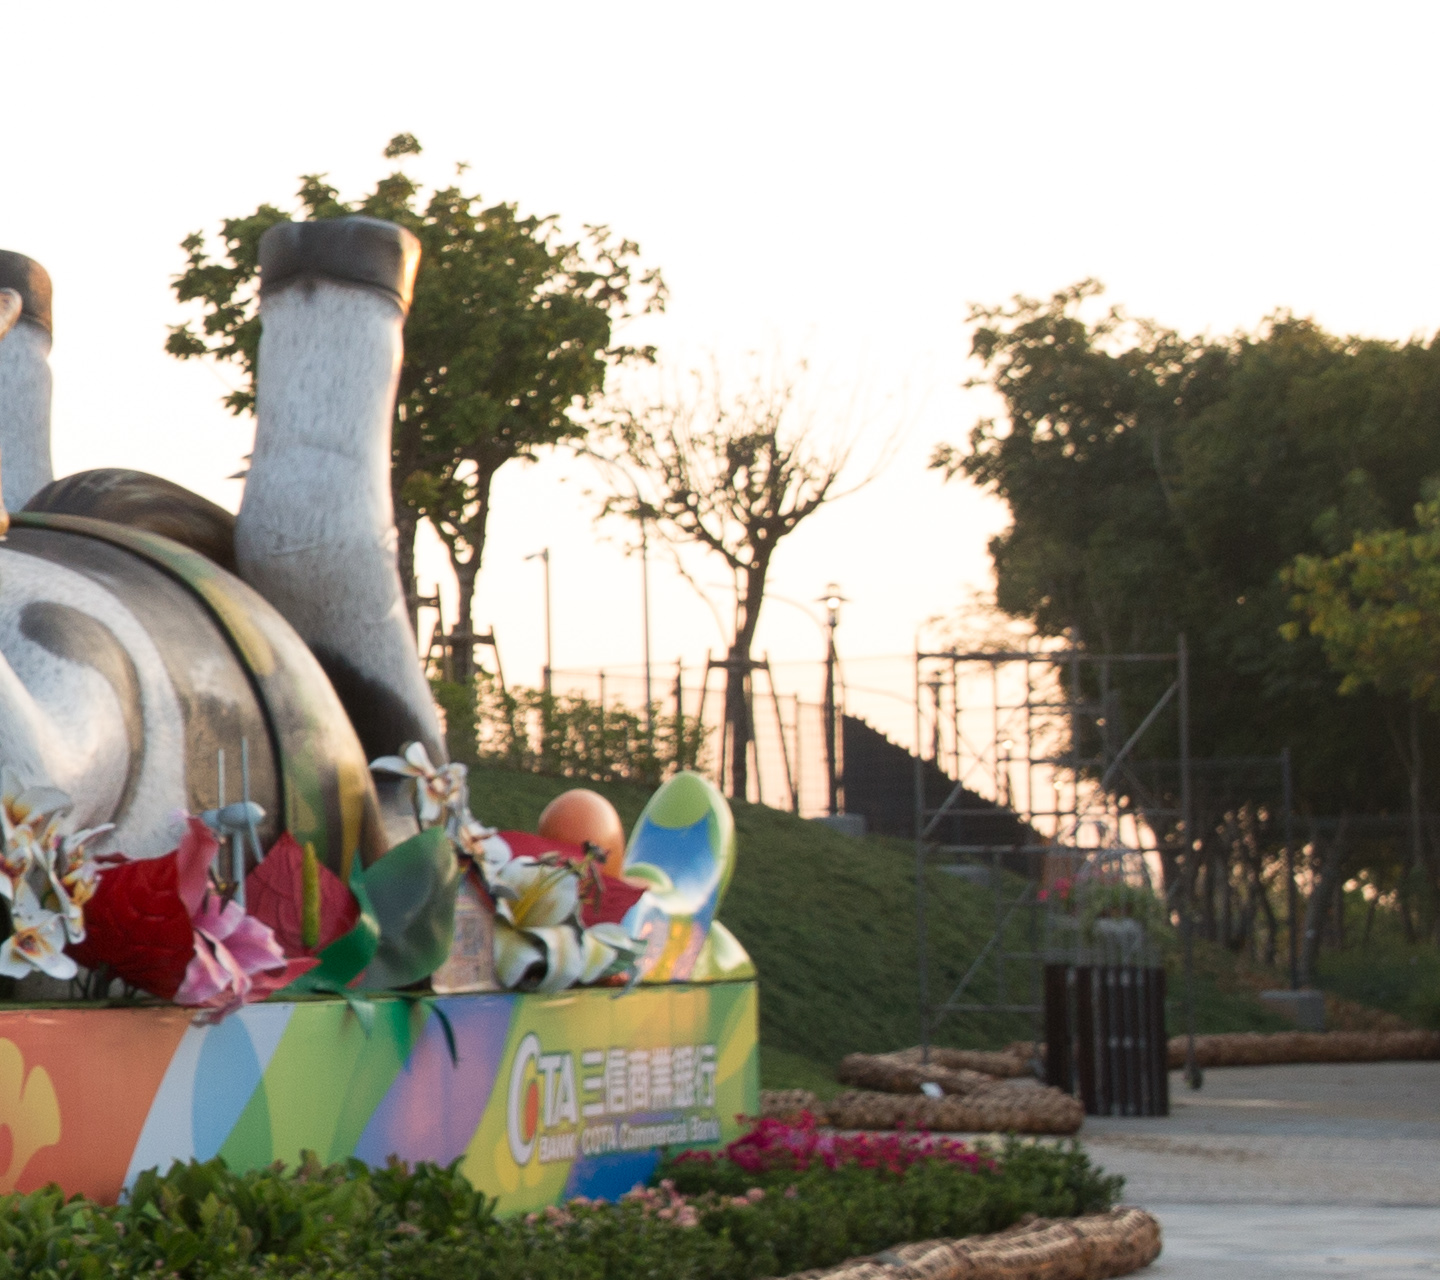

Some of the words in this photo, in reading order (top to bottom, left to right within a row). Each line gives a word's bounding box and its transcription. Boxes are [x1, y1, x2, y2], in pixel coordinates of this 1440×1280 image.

[582, 1044, 717, 1117] 三信商業銀行
[538, 1132, 577, 1164] BANK
[582, 1123, 616, 1155] COTA
[619, 1120, 687, 1150] Commercial
[691, 1115, 719, 1143] Bank
